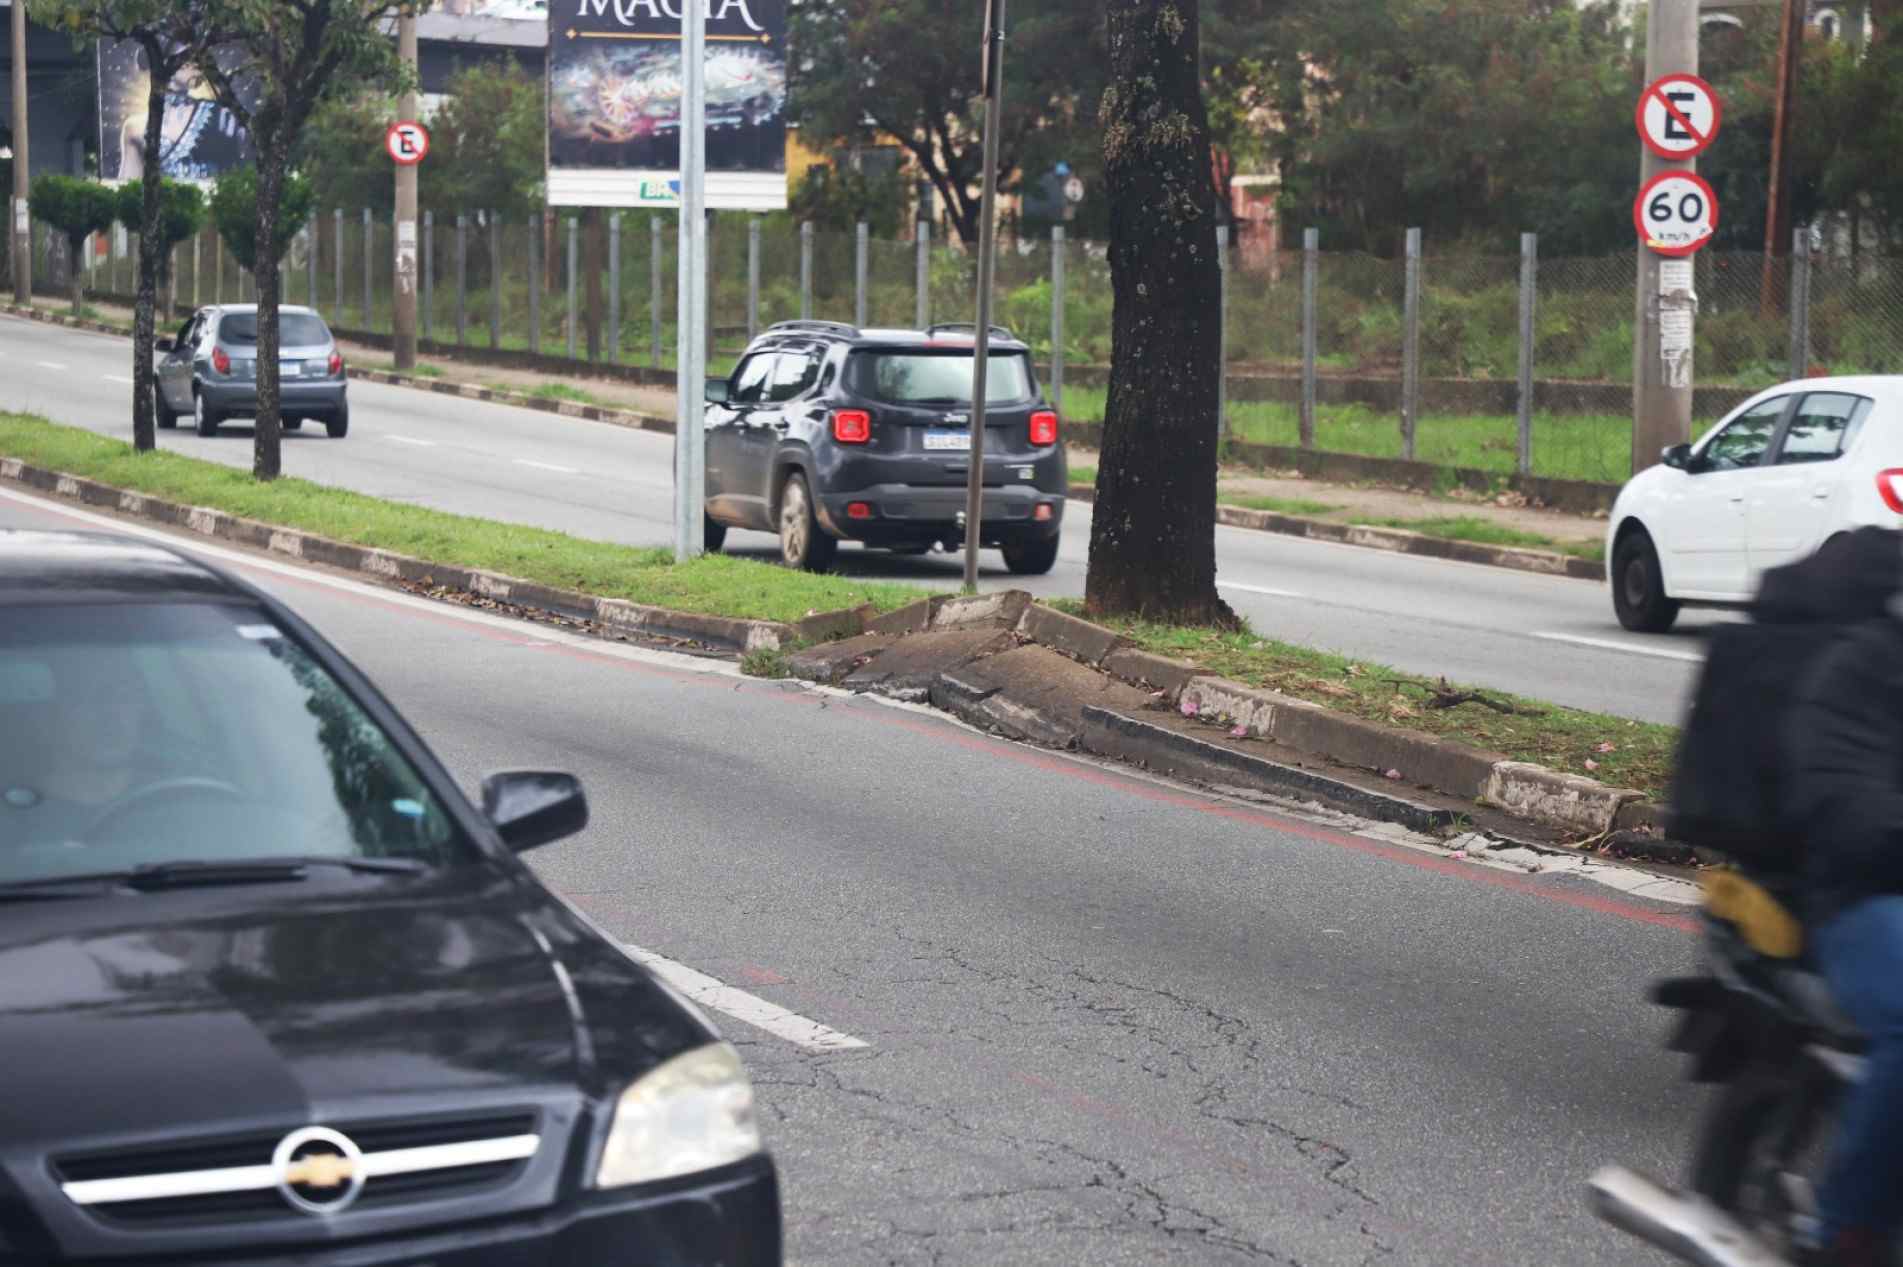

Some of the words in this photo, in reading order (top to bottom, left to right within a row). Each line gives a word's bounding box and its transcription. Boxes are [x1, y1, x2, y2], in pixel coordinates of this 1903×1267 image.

[576, 0, 765, 31] MAA
[1665, 92, 1695, 139] E
[1649, 192, 1703, 223] 60
